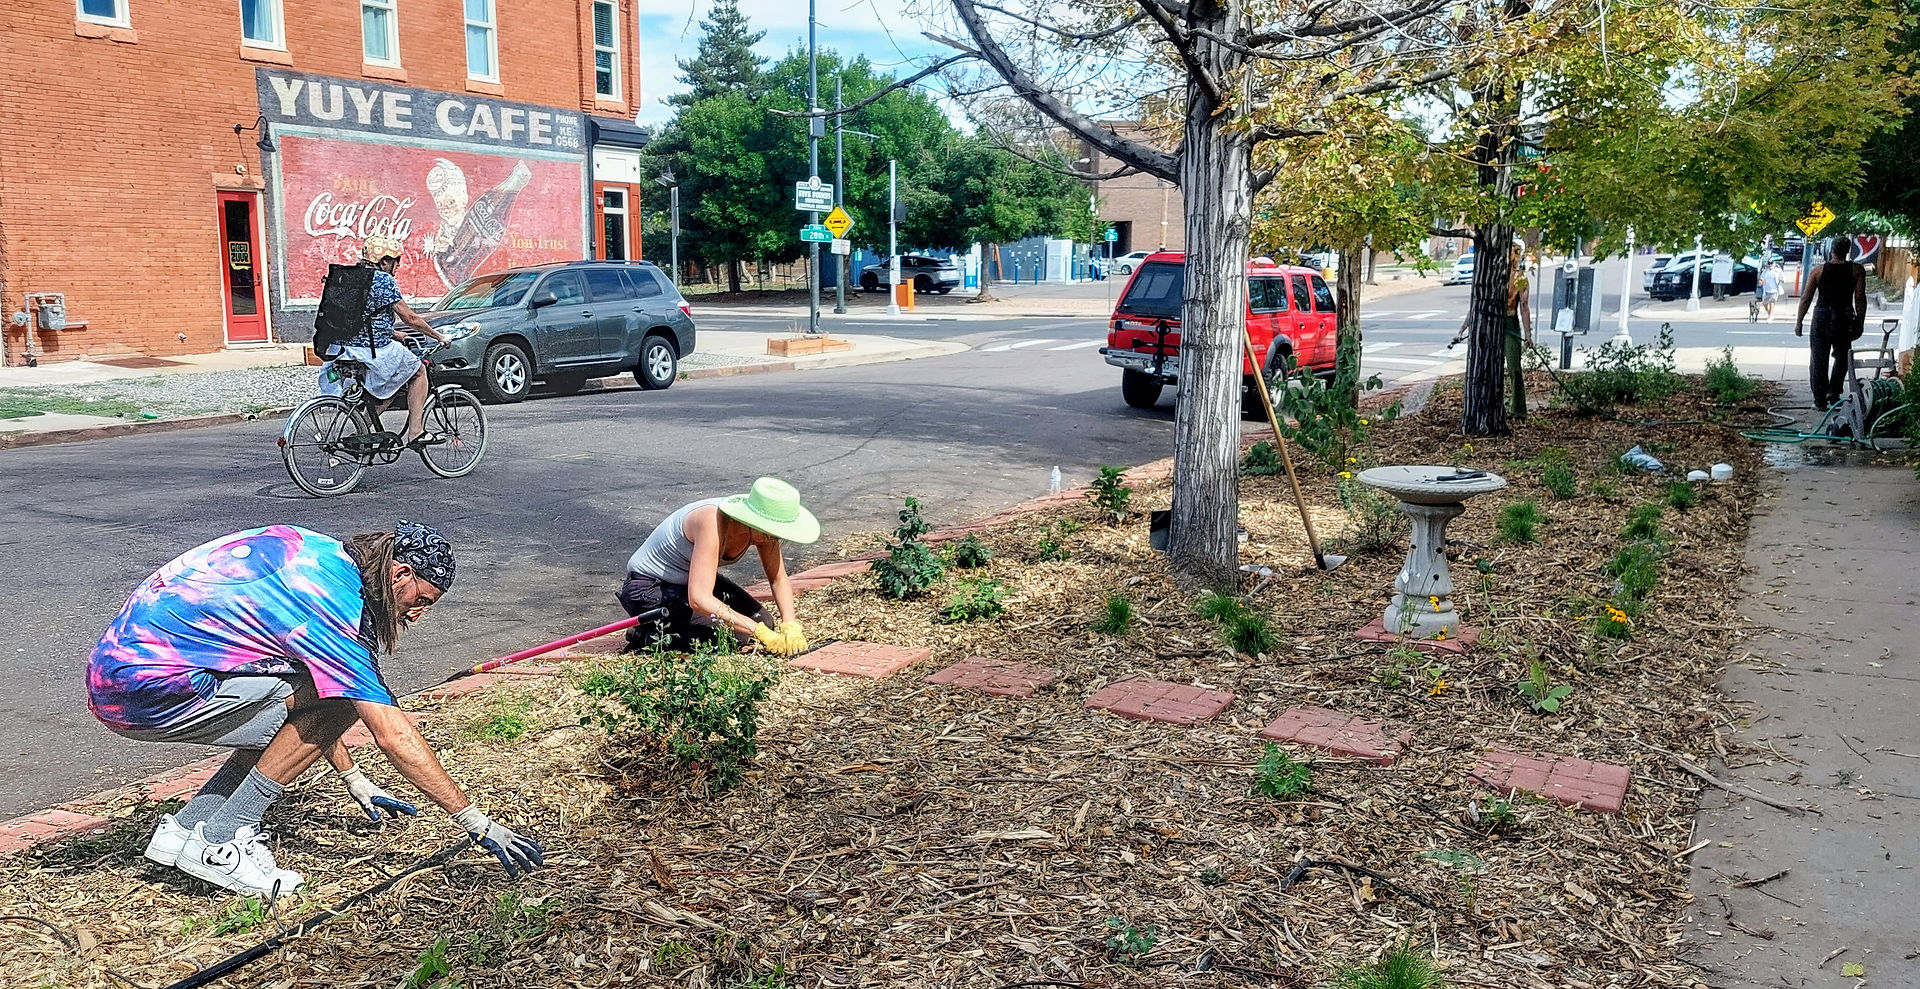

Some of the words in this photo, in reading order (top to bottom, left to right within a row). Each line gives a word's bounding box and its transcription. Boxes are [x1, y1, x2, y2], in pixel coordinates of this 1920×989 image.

[268, 76, 413, 130] YUYE
[435, 99, 553, 145] CAFE
[555, 114, 578, 126] PHONE
[304, 191, 418, 241] Coca-Cola
[510, 231, 533, 249] You
[538, 235, 568, 250] trust
